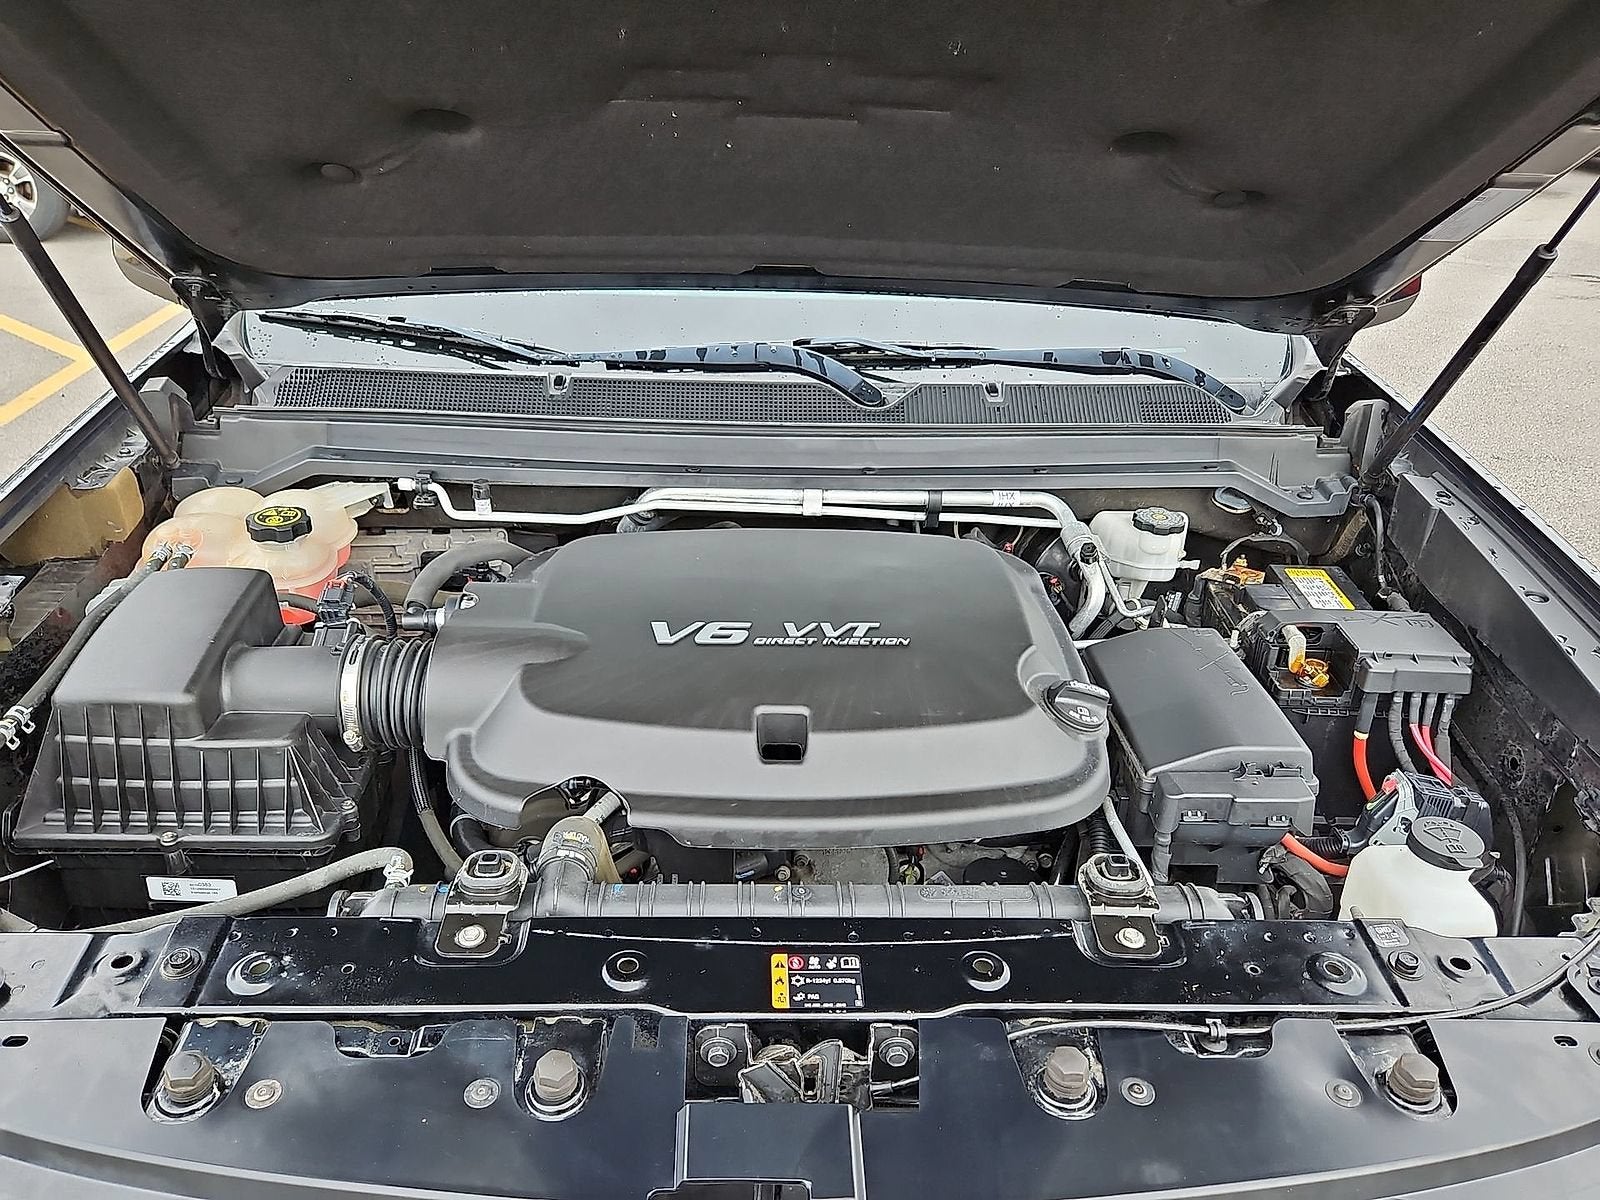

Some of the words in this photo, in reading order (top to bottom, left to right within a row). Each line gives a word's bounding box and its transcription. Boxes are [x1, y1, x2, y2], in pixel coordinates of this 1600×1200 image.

[651, 621, 753, 645] V6
[783, 622, 881, 637] VVT
[753, 637, 818, 646] DIRECT
[822, 637, 911, 646] INJECTION
